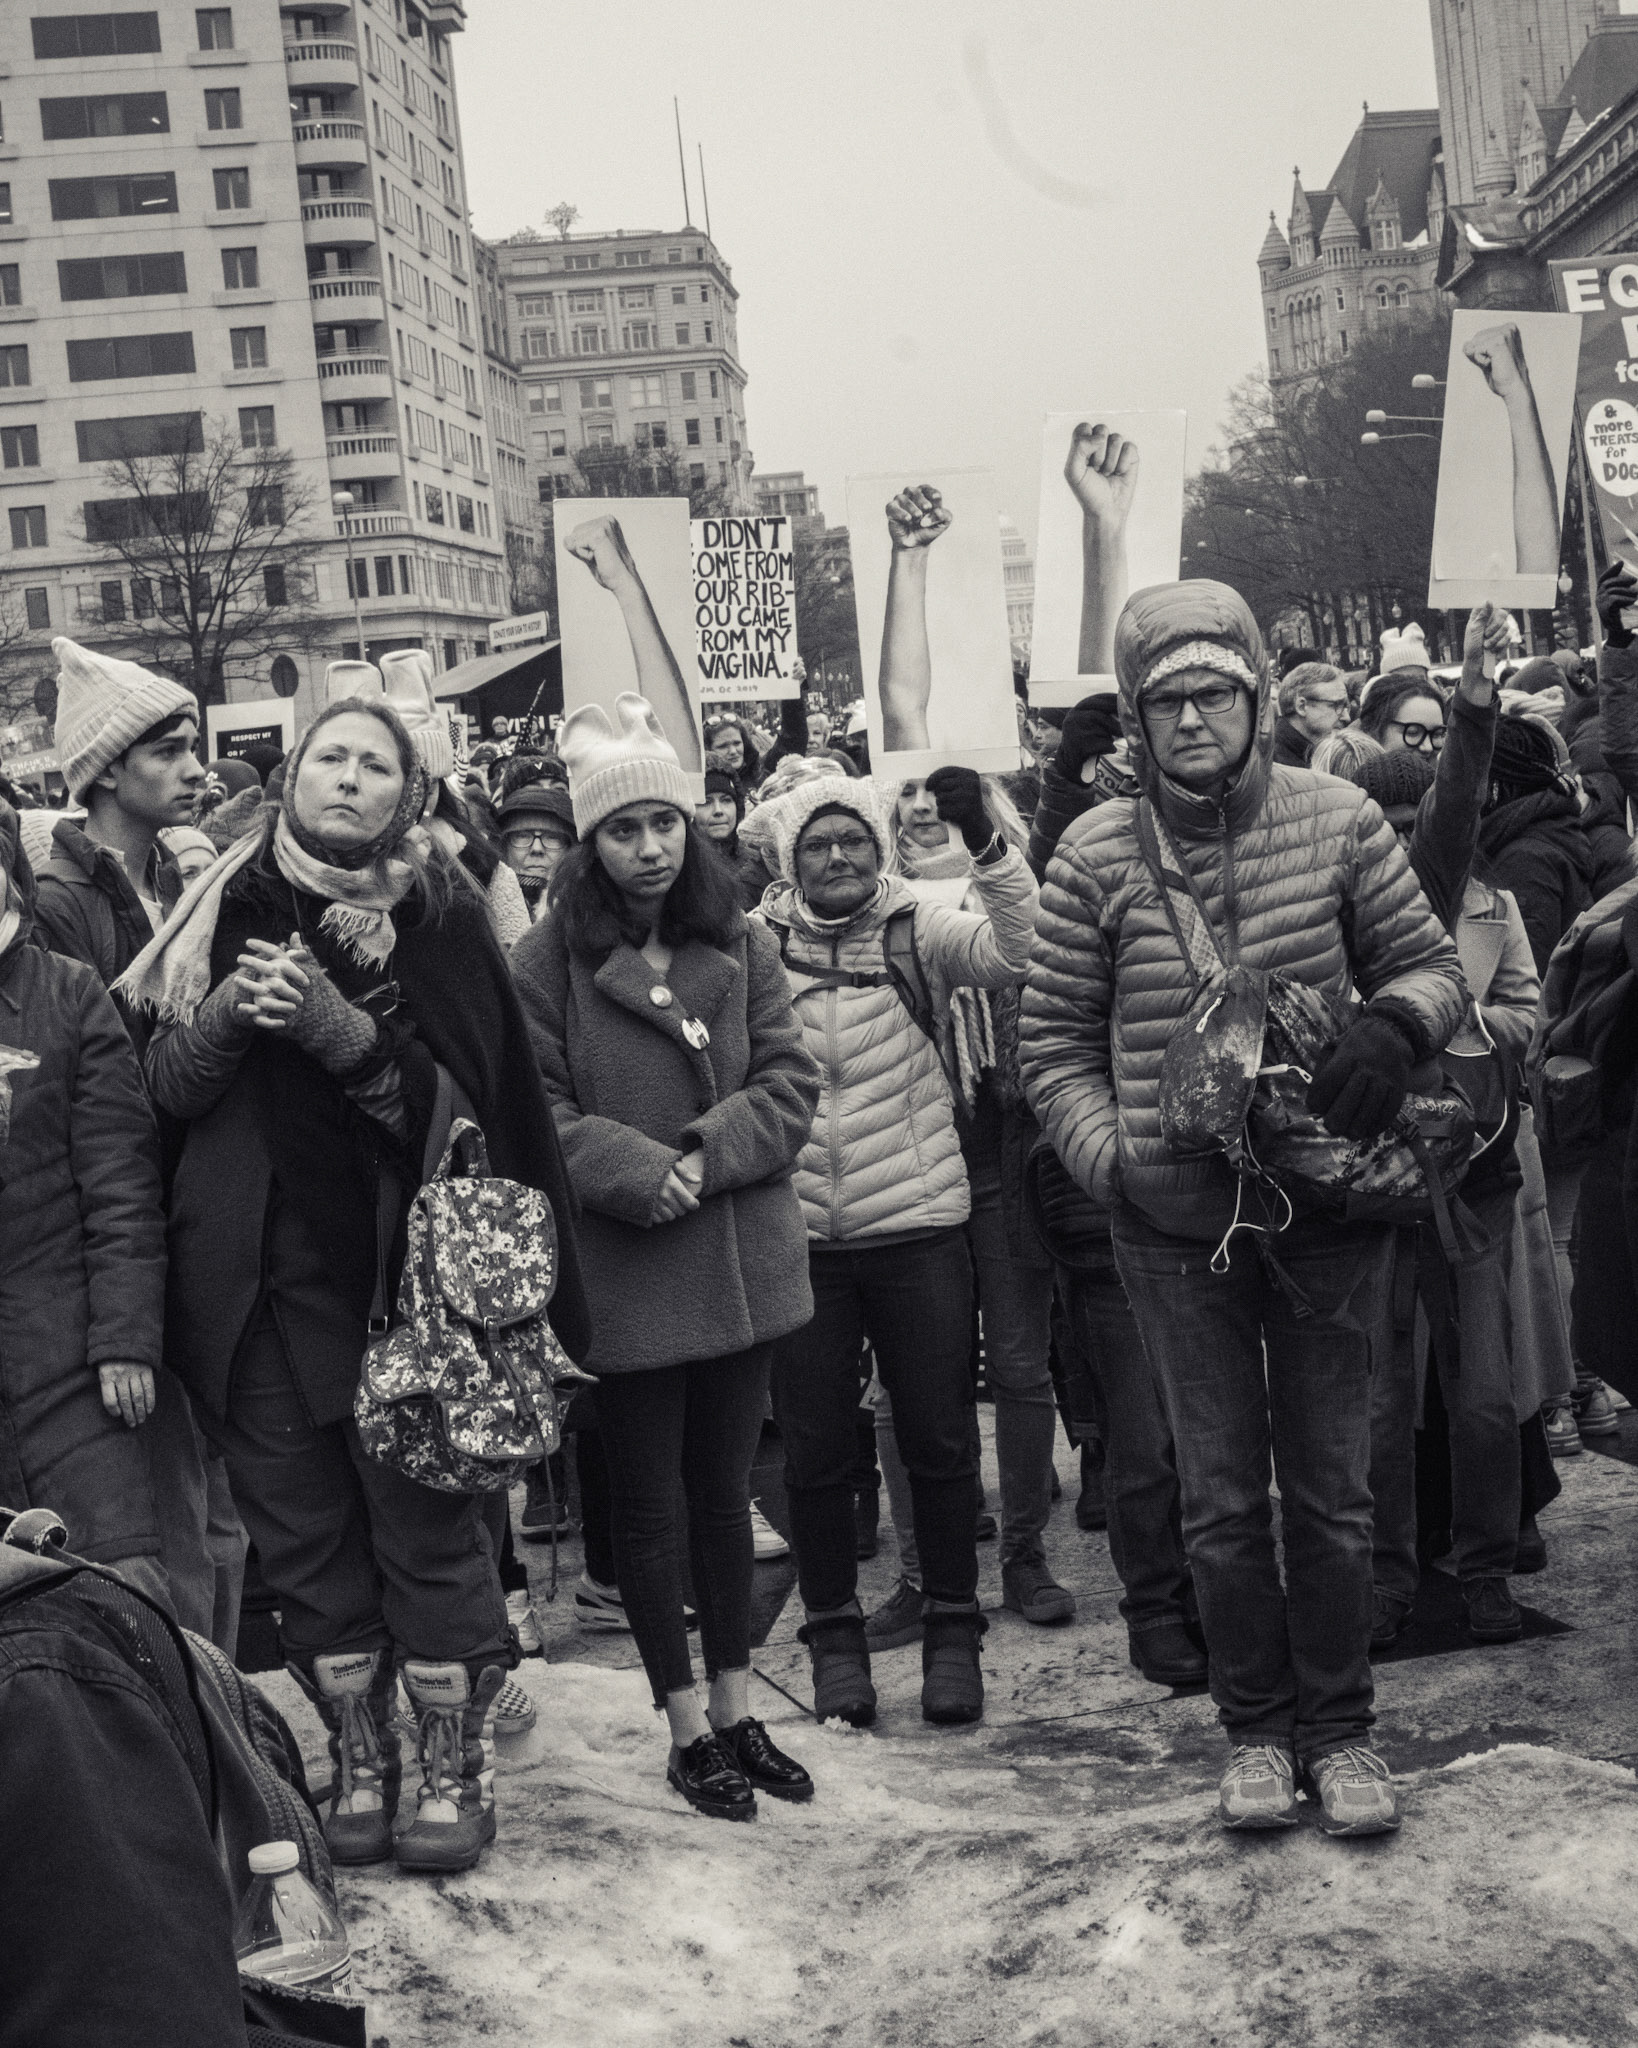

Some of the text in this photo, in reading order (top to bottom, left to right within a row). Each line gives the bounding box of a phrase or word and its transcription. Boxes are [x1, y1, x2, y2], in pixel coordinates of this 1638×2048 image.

[1604, 404, 1617, 418] &
[1594, 420, 1633, 434] more
[1588, 433, 1638, 447] TREATS
[1606, 447, 1627, 458] for
[703, 517, 787, 550] DIDN'T
[693, 551, 794, 581] OME FROM
[694, 580, 741, 606] OUR
[696, 604, 792, 629] OU CAME
[697, 627, 791, 653] ROM MY
[698, 651, 789, 679] VAGINA.
[231, 731, 272, 742] RESPECT MY
[331, 1656, 371, 1675] Timberland
[413, 1676, 452, 1686] Timberland
